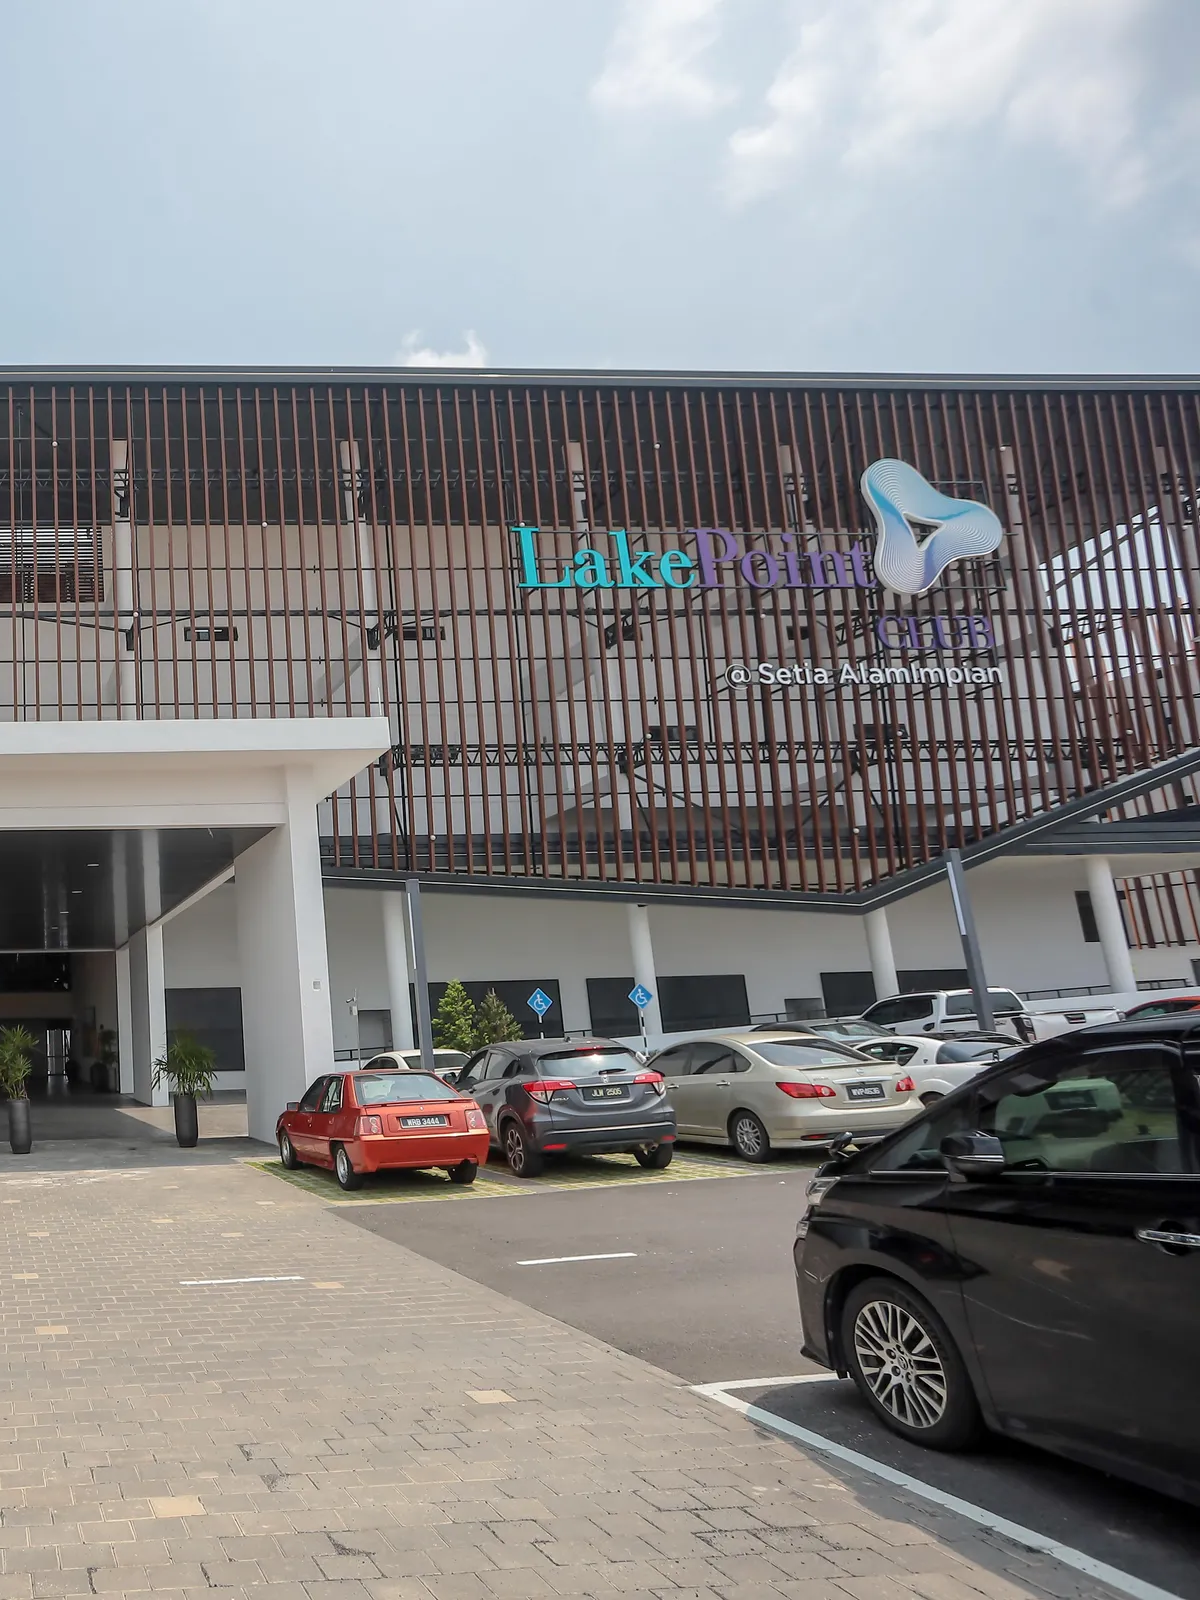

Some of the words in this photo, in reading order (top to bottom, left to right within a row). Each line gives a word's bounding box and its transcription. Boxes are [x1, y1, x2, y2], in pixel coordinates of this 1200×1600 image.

[511, 526, 877, 589] LakePoint
[876, 615, 996, 650] CLUB
[758, 662, 829, 686] Setia
[839, 662, 1003, 687] AlamImpian
[421, 1117, 440, 1125] 3444
